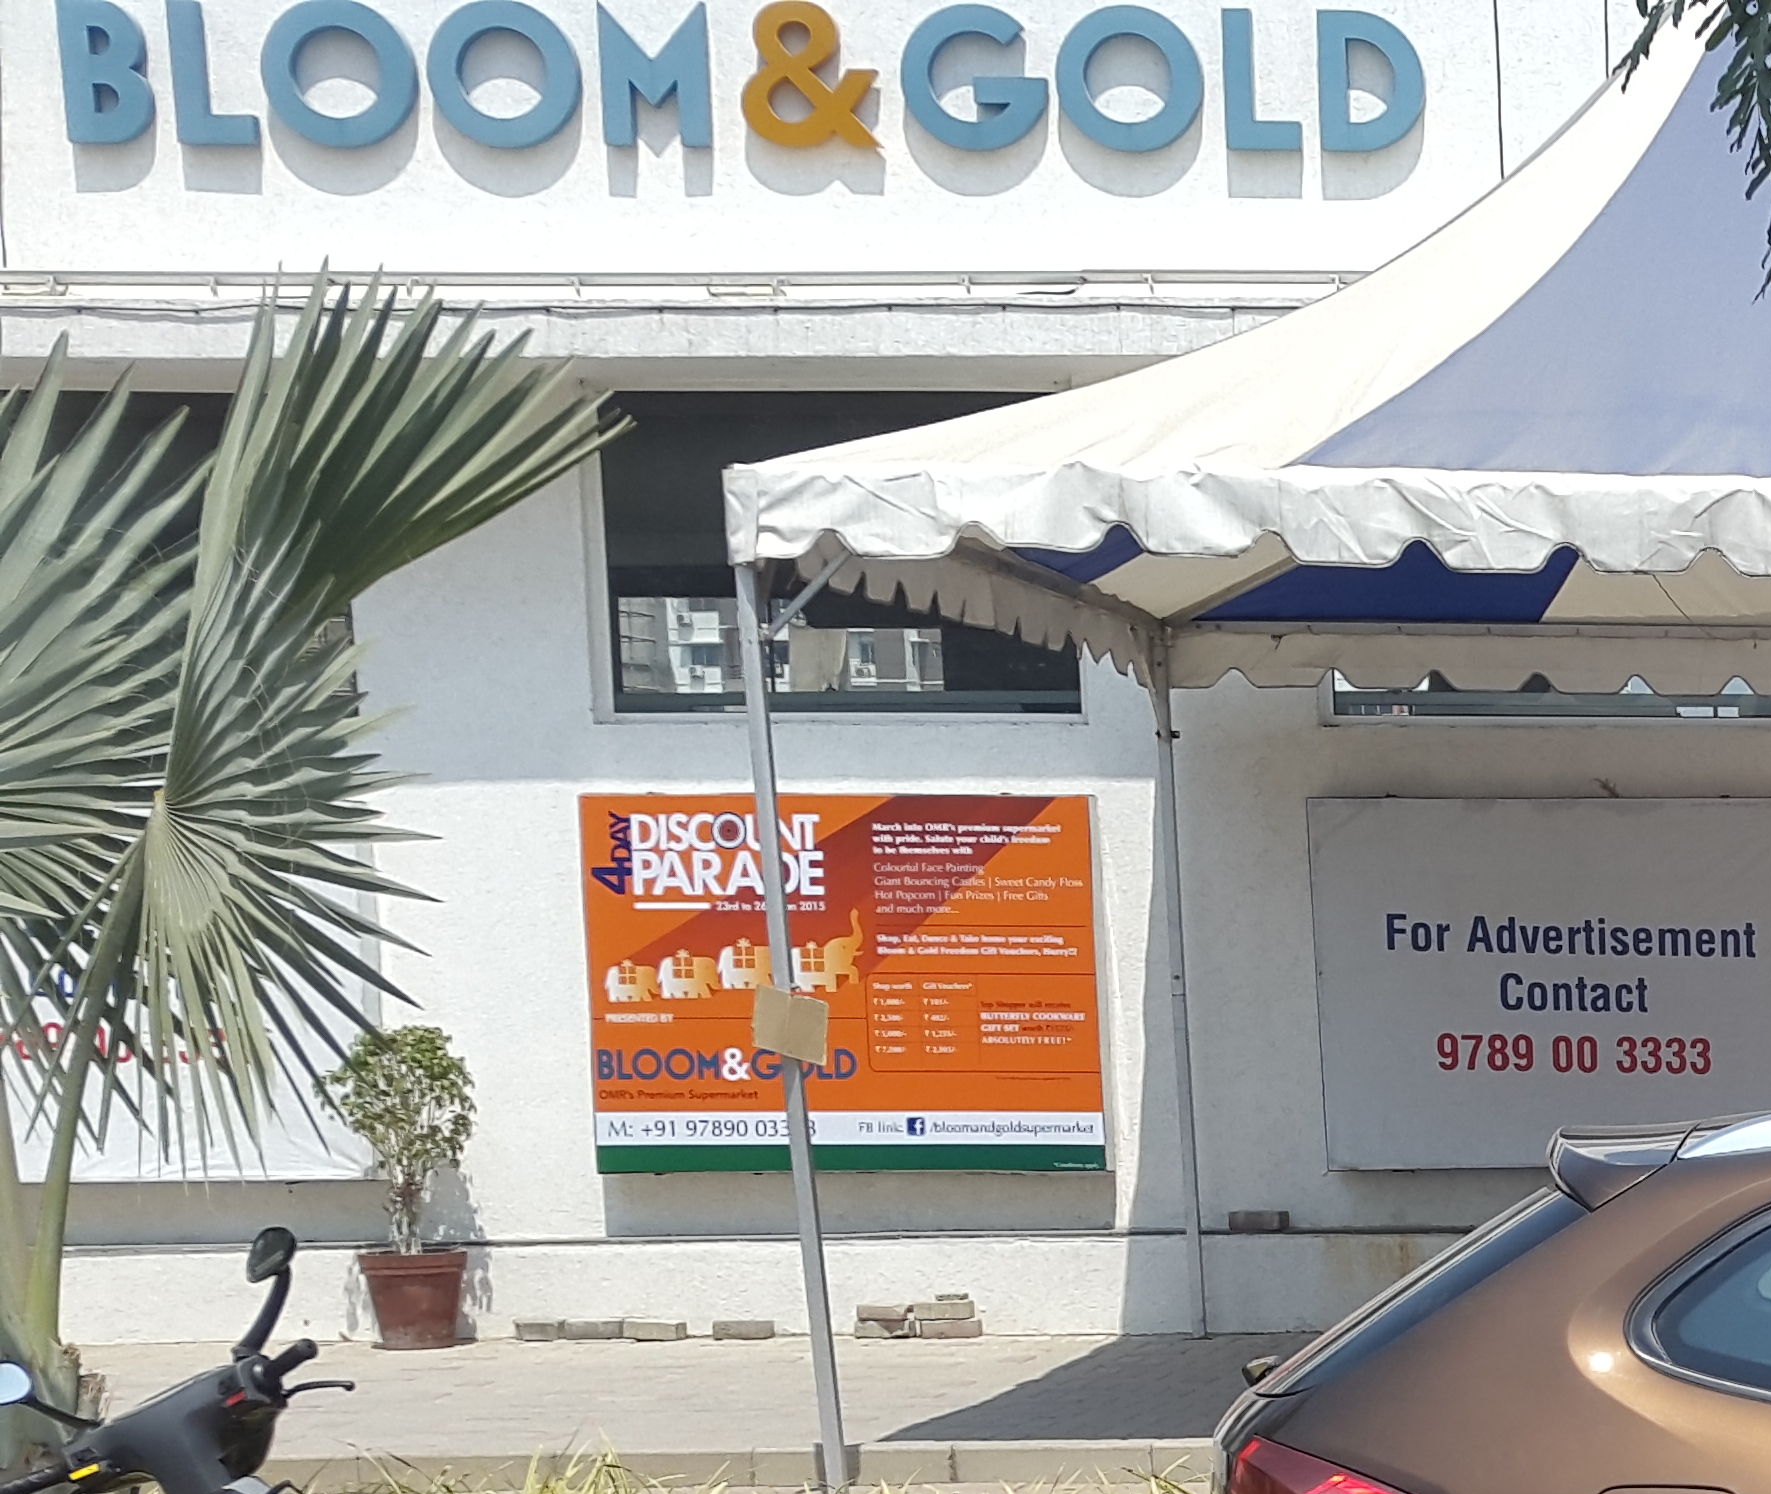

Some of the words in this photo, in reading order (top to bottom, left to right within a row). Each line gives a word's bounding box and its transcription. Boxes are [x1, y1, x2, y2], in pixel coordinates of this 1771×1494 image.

[630, 812, 820, 850] DISCOUNT
[872, 823, 901, 831] March
[904, 823, 922, 831] into
[958, 824, 1000, 834] premium
[1003, 824, 1061, 834] supermarket
[872, 834, 893, 842] with
[956, 836, 977, 845] your
[1011, 835, 1050, 843] freedom
[874, 862, 918, 872] Colourful
[922, 862, 943, 872] Face
[946, 862, 984, 875] Painting
[875, 876, 900, 886] Giant
[904, 876, 949, 888] Bouncing
[952, 876, 985, 886] Castles
[995, 877, 1023, 887] Sweet
[1026, 877, 1055, 889] Candy
[1060, 877, 1083, 887] Floss
[875, 891, 892, 900] Hot
[896, 891, 935, 902] Popcorn
[945, 891, 963, 900] Fun
[966, 891, 994, 900] Prizes
[1003, 891, 1024, 900] Free
[1026, 891, 1049, 900] Gifts
[741, 902, 752, 911] to
[754, 901, 767, 911] 26
[799, 901, 826, 911] 2015
[876, 904, 893, 913] and
[897, 904, 923, 913] much
[1386, 913, 1450, 951] For
[1467, 915, 1756, 957] Advertisement
[1501, 972, 1648, 1013] Contact
[1437, 1033, 1534, 1071] 9789
[1552, 1036, 1598, 1073] 00
[1616, 1037, 1712, 1075] 3333
[638, 1089, 684, 1100] Premium
[688, 1089, 759, 1102] Supermarket
[608, 1120, 634, 1137] M:
[641, 1119, 676, 1137] +91
[686, 1119, 748, 1137] 97890
[858, 1122, 873, 1133] FB
